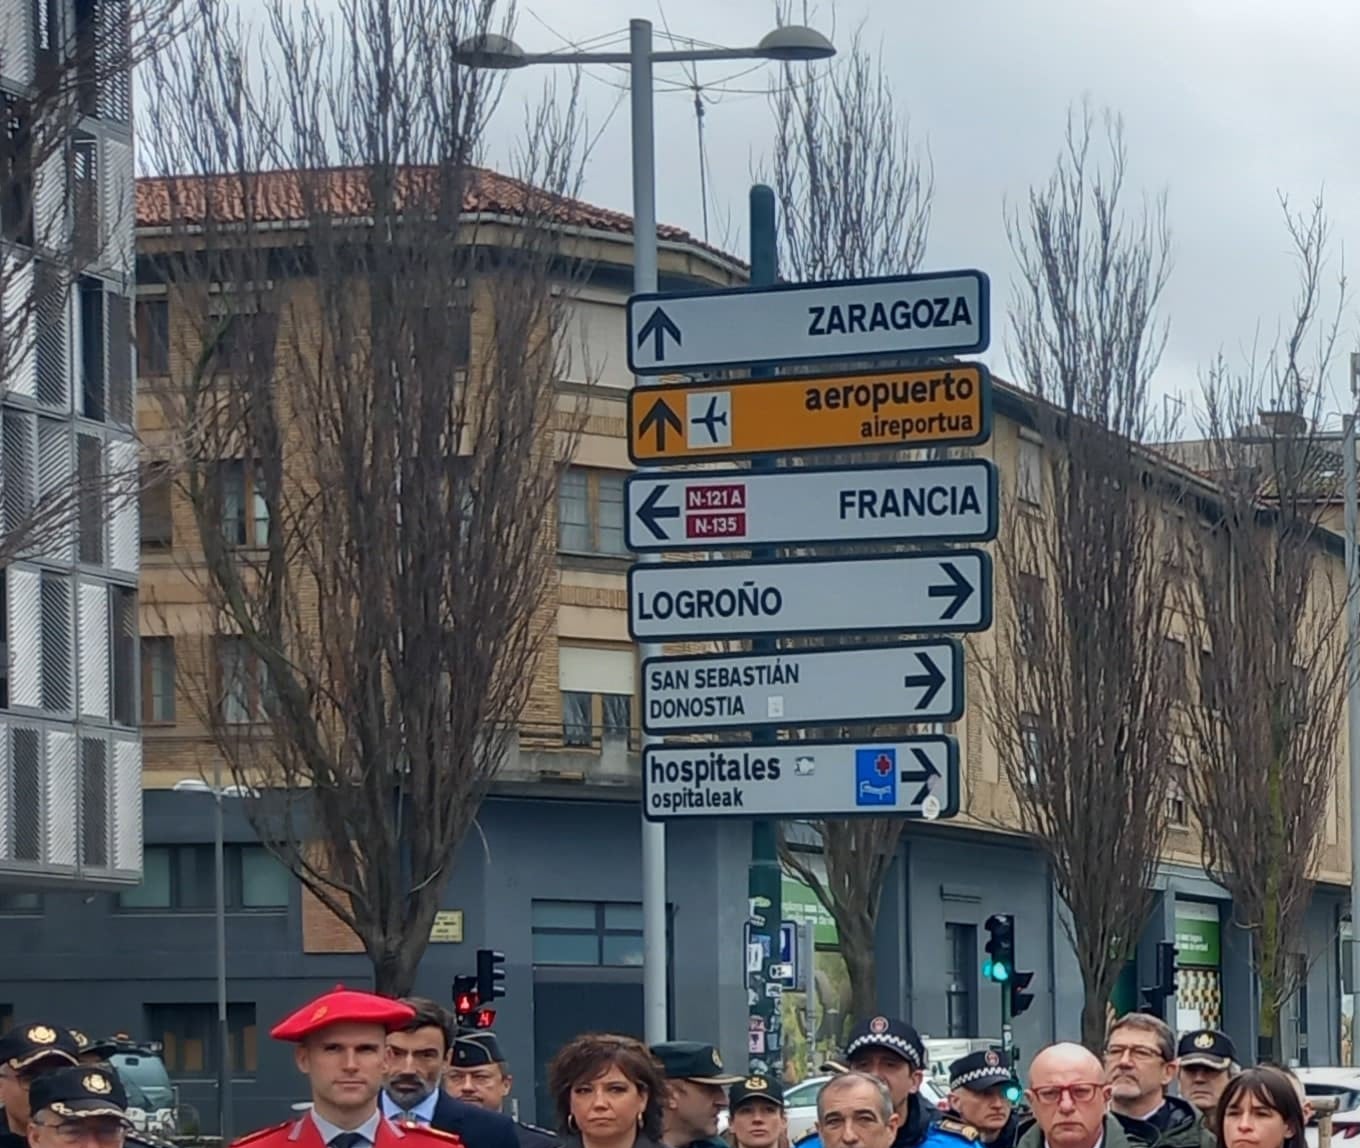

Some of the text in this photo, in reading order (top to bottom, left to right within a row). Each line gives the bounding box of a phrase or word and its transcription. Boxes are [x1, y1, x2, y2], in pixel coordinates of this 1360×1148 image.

[808, 296, 972, 335] ZARAGOZA
[805, 372, 973, 412] aeropuerto
[860, 414, 973, 440] aireportua
[839, 485, 981, 519] FRANCIA
[695, 518, 737, 533] N-135
[638, 580, 782, 620] LOGROÑO
[650, 658, 799, 691] SAN SEBASTIÁN
[650, 695, 745, 719] DONOSTIA
[651, 752, 780, 789] hospitales
[652, 787, 743, 812] ospitaleak
